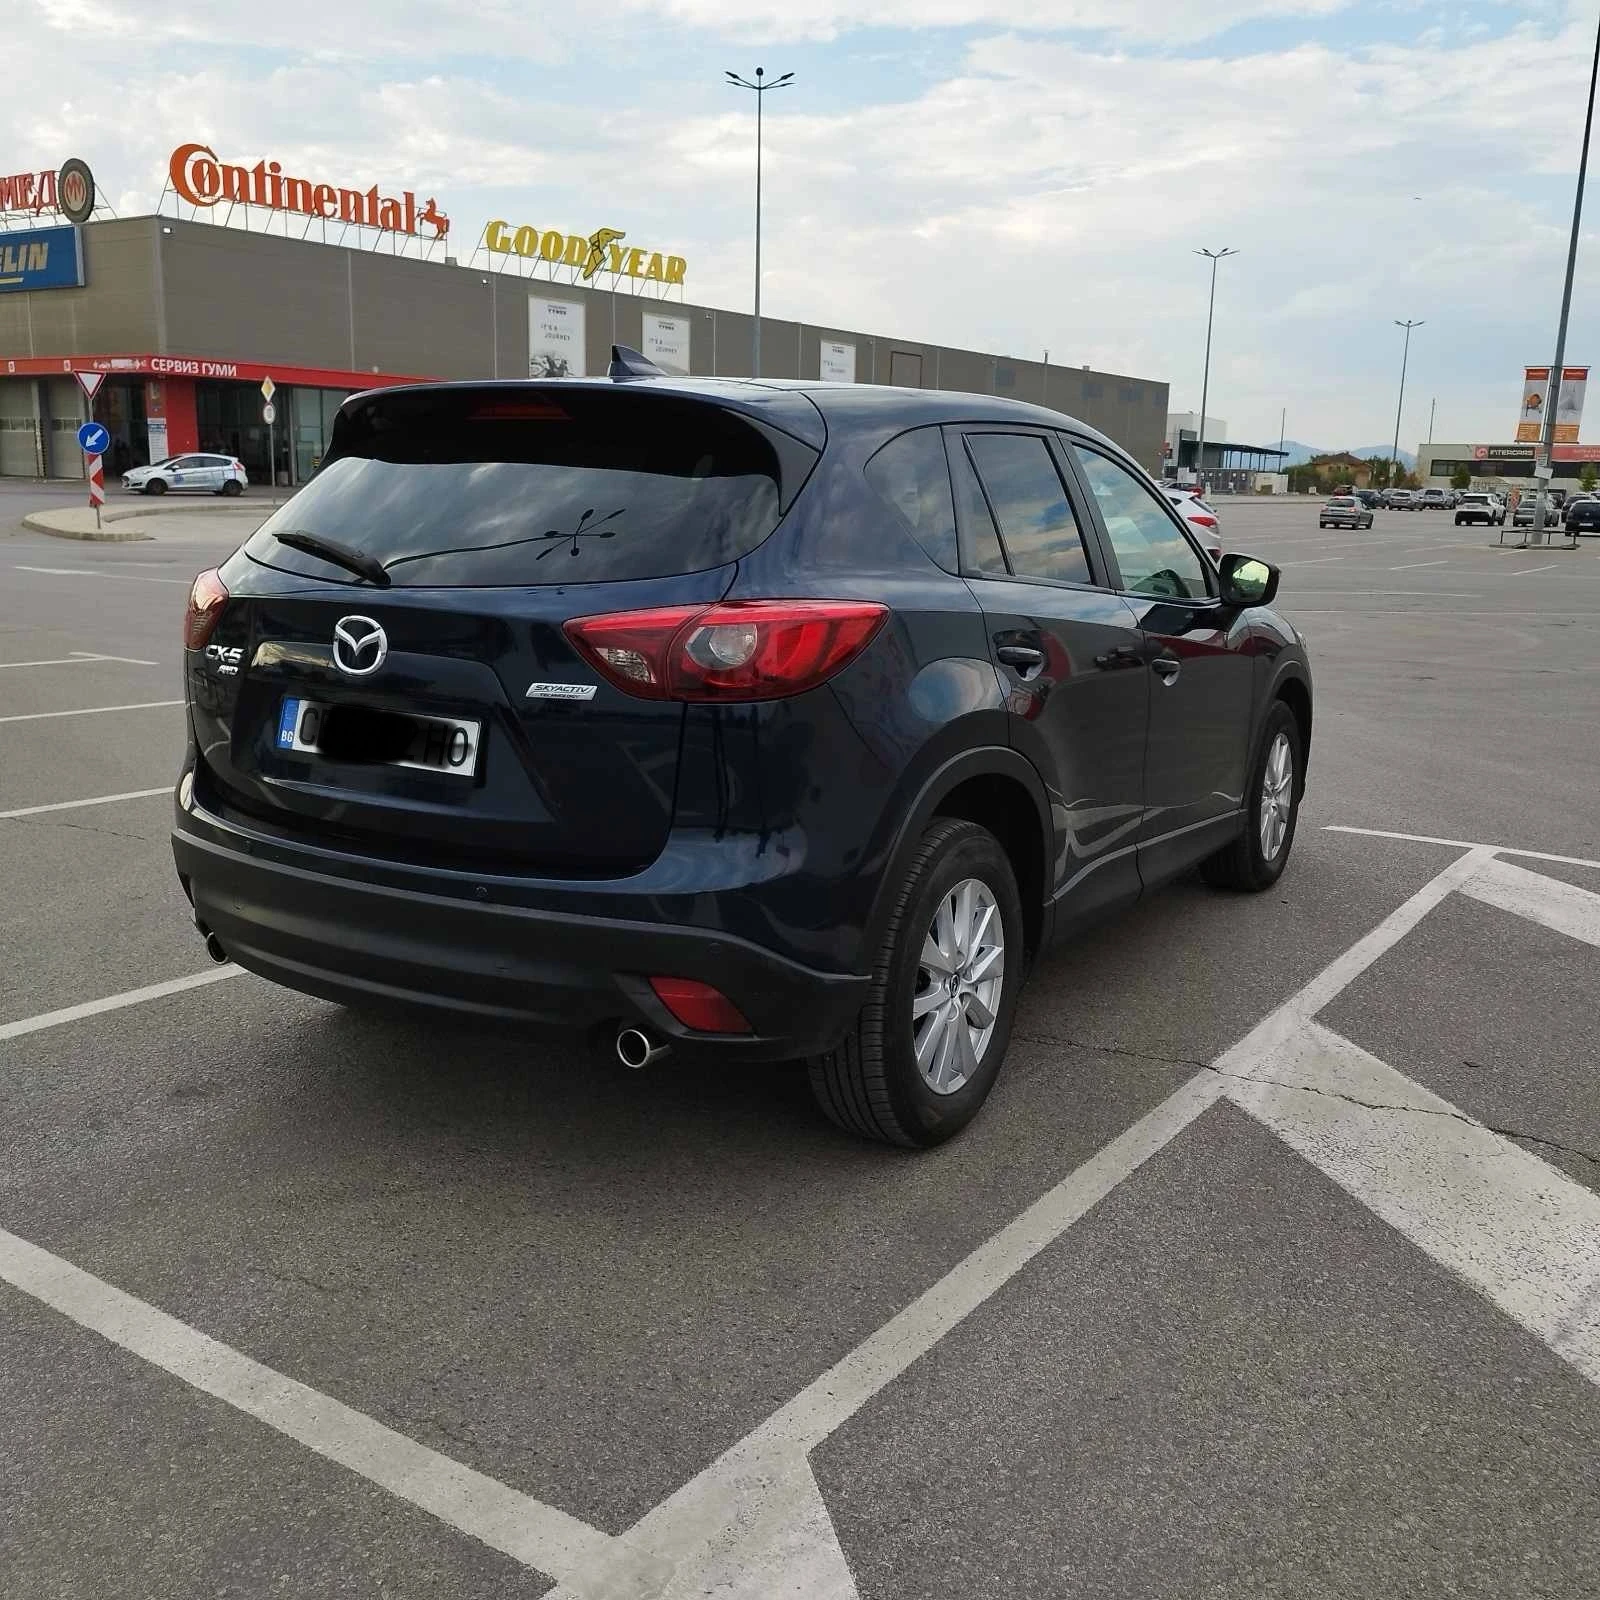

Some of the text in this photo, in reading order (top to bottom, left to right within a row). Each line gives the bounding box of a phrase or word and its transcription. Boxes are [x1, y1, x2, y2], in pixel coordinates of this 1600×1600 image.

[169, 143, 416, 236] Continental
[0, 242, 49, 273] LIN
[151, 358, 237, 377] СЕРВИЗ ГУМИ
[205, 644, 245, 664] CX-5
[533, 684, 592, 694] SKYACTIV
[281, 730, 294, 743] BG
